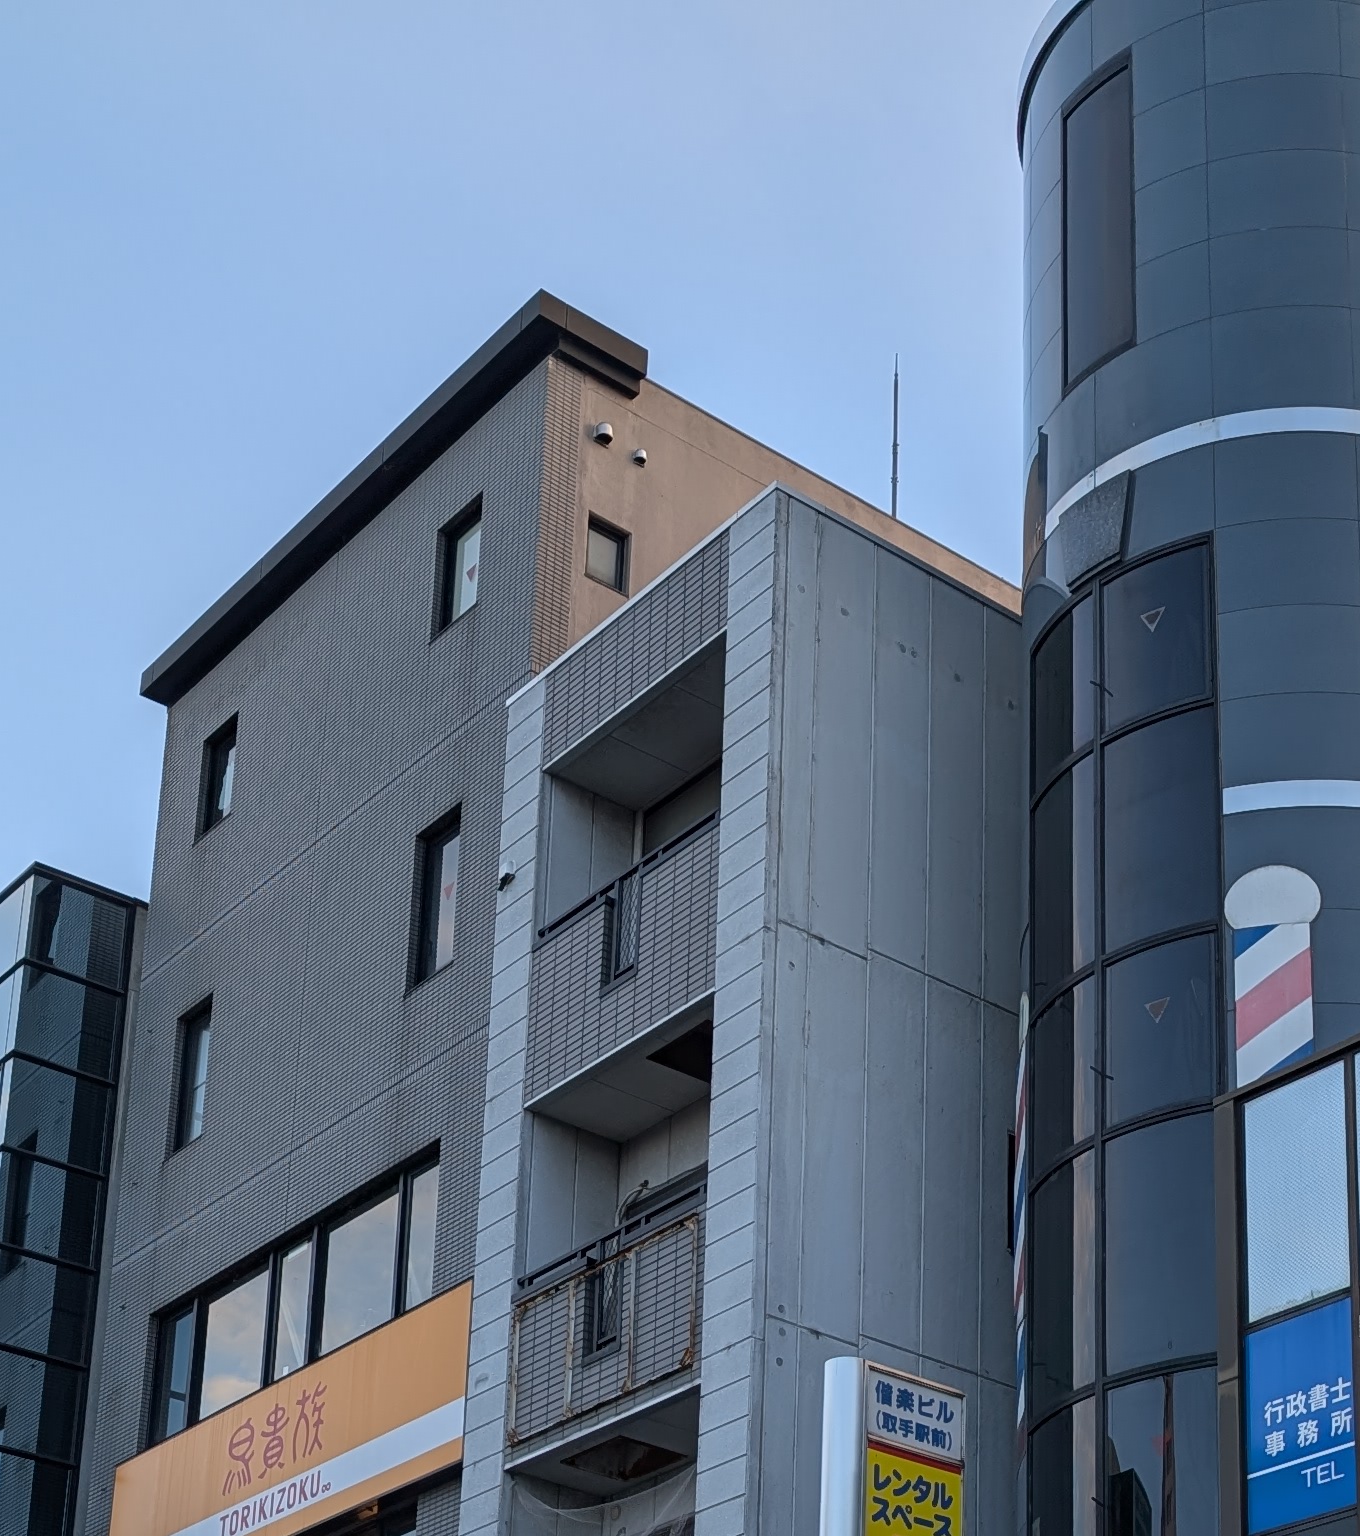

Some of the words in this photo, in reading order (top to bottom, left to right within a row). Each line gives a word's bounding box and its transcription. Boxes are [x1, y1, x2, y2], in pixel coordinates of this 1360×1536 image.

[1264, 1377, 1352, 1427] 行政書士
[1264, 1406, 1353, 1457] 事務所
[871, 1462, 954, 1511] レンタル
[1301, 1460, 1345, 1489] TEL
